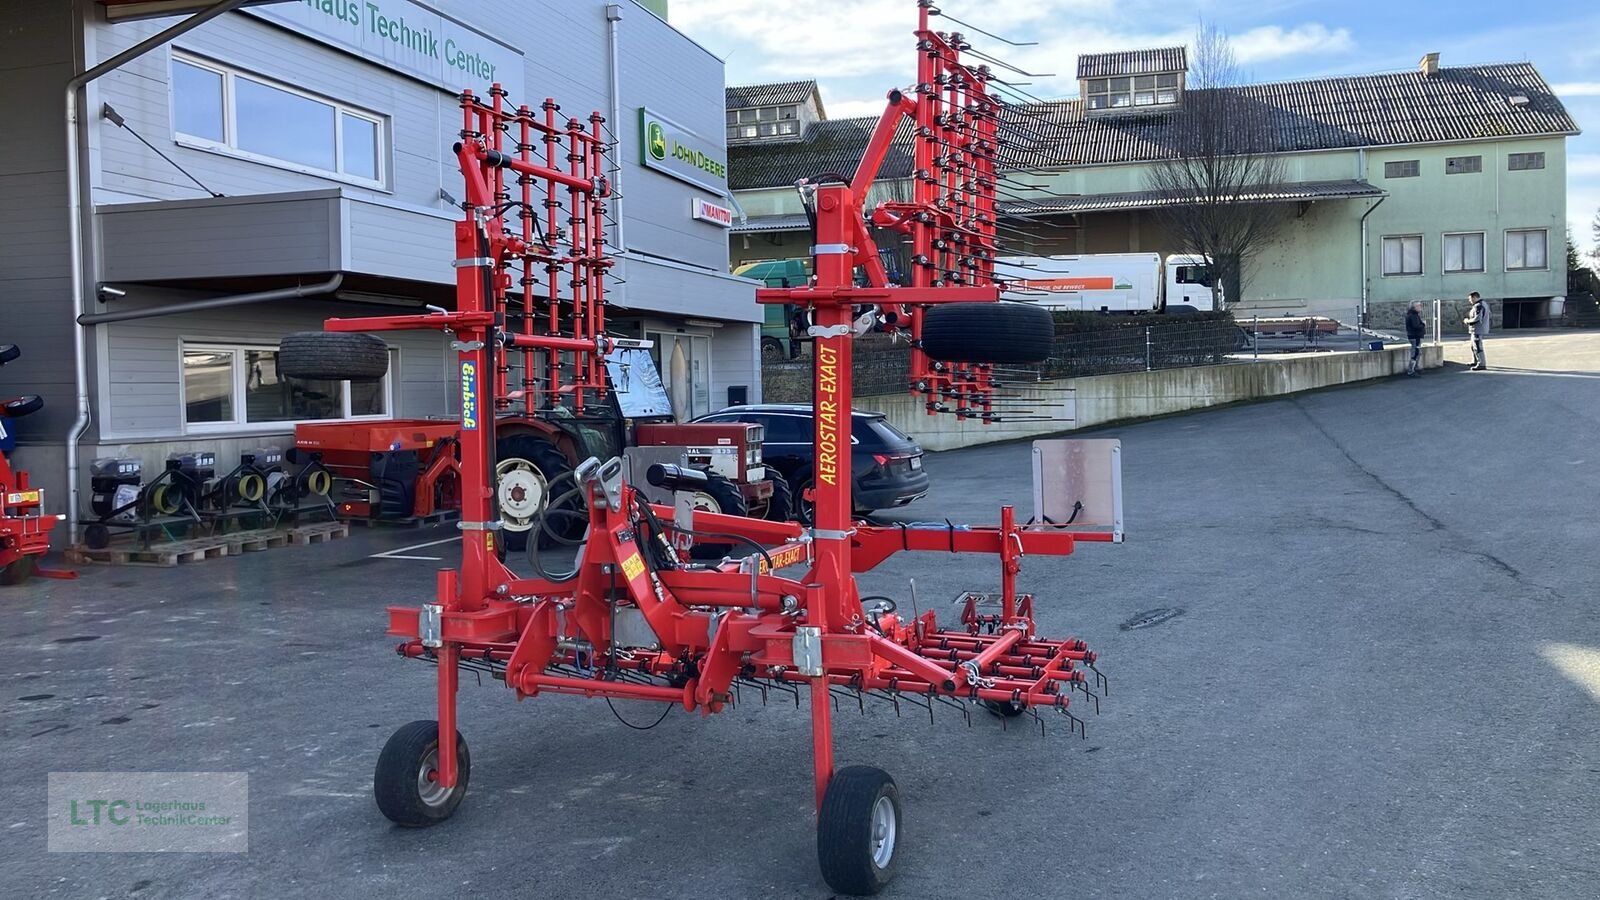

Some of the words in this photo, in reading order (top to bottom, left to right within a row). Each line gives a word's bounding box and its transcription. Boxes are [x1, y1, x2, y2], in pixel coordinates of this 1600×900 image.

[366, 2, 439, 60] Technik
[444, 38, 496, 83] Center
[671, 138, 697, 166] JOHN
[697, 151, 725, 179] DEERE
[462, 362, 476, 428] Einböck
[820, 344, 837, 485] AEROSTAR-EXACT
